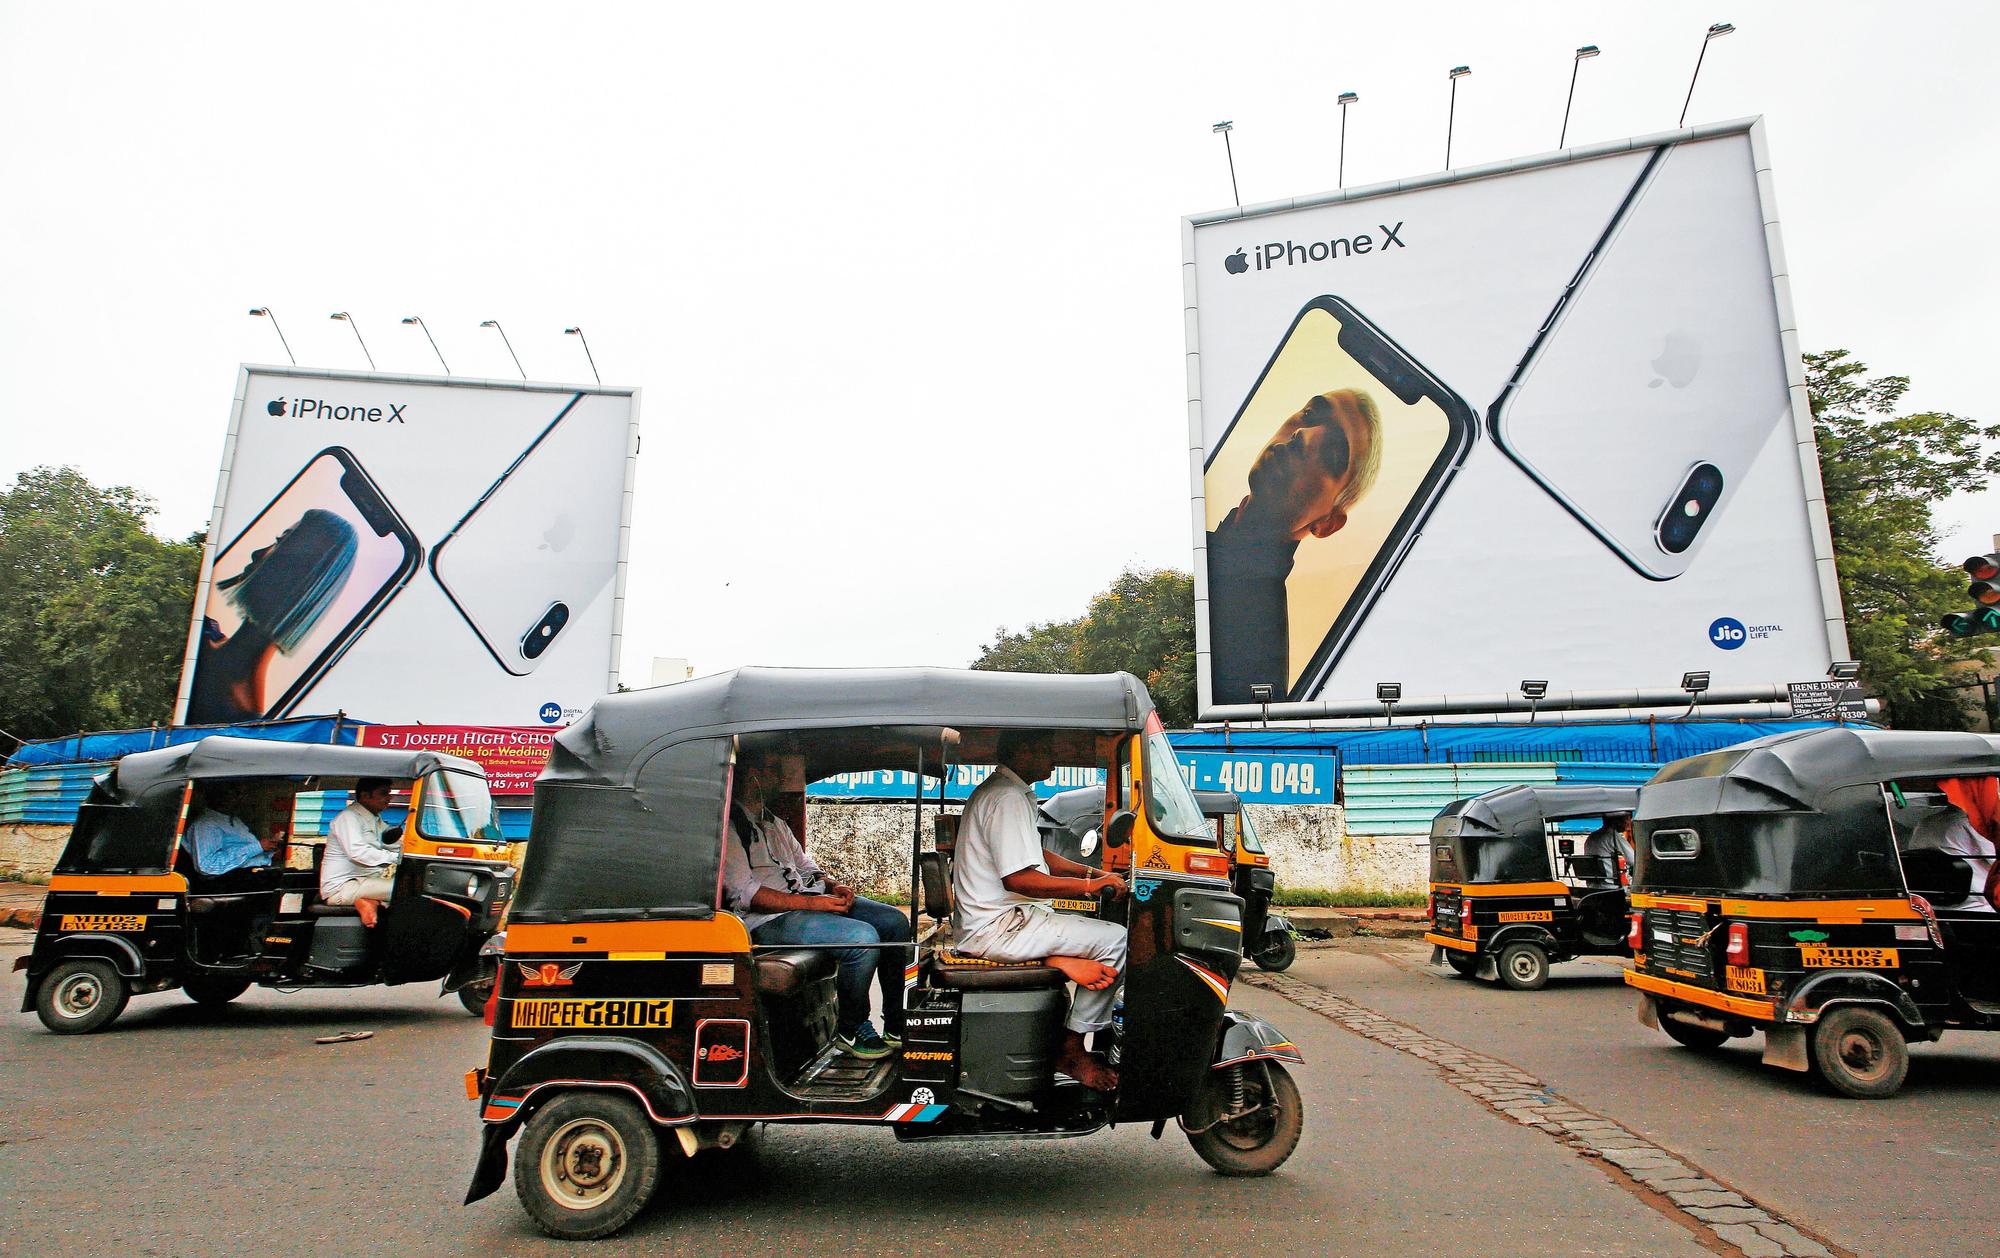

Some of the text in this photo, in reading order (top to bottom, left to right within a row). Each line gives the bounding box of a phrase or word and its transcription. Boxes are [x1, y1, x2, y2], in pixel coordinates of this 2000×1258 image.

[1255, 221, 1406, 271] iPhone X
[291, 398, 407, 424] iPhone X
[1713, 625, 1744, 641] Jio
[1791, 680, 1860, 692] IRENE DISPAY
[541, 707, 560, 718] Jio
[380, 731, 554, 748] ST. JOSEPH HIGH SCHO
[477, 746, 494, 757] for
[498, 746, 550, 759] Wedding
[488, 780, 506, 788] 145
[1218, 761, 1263, 793] 400
[1271, 762, 1321, 795] 049.
[906, 1017, 953, 1027] NO ENTRY
